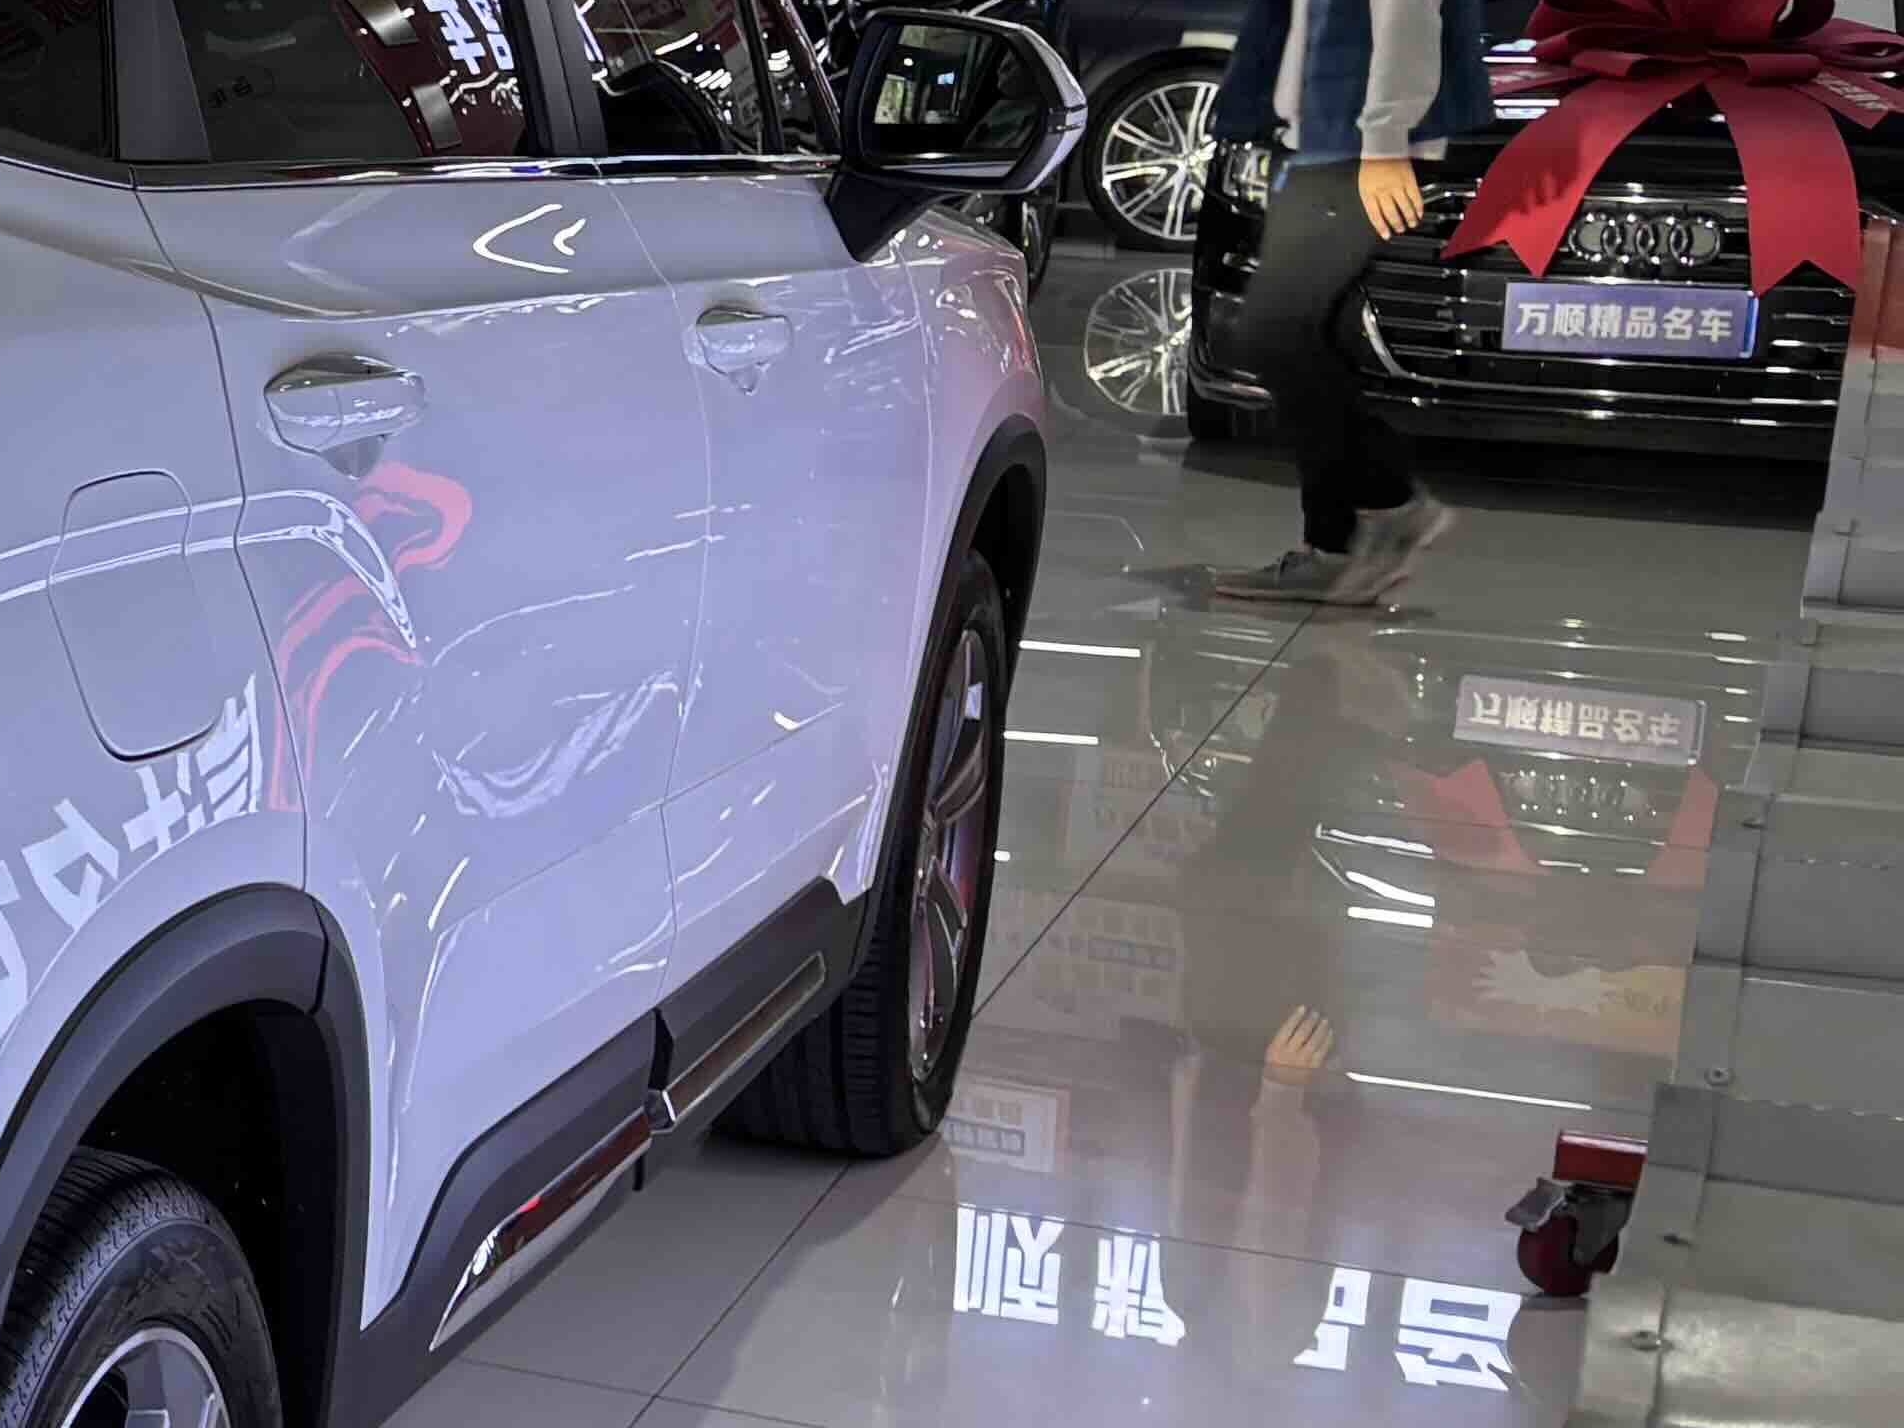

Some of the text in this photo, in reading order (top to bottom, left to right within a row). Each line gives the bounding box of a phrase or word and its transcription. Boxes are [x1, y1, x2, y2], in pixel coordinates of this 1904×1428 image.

[1515, 302, 1733, 343] 万顺精品名车
